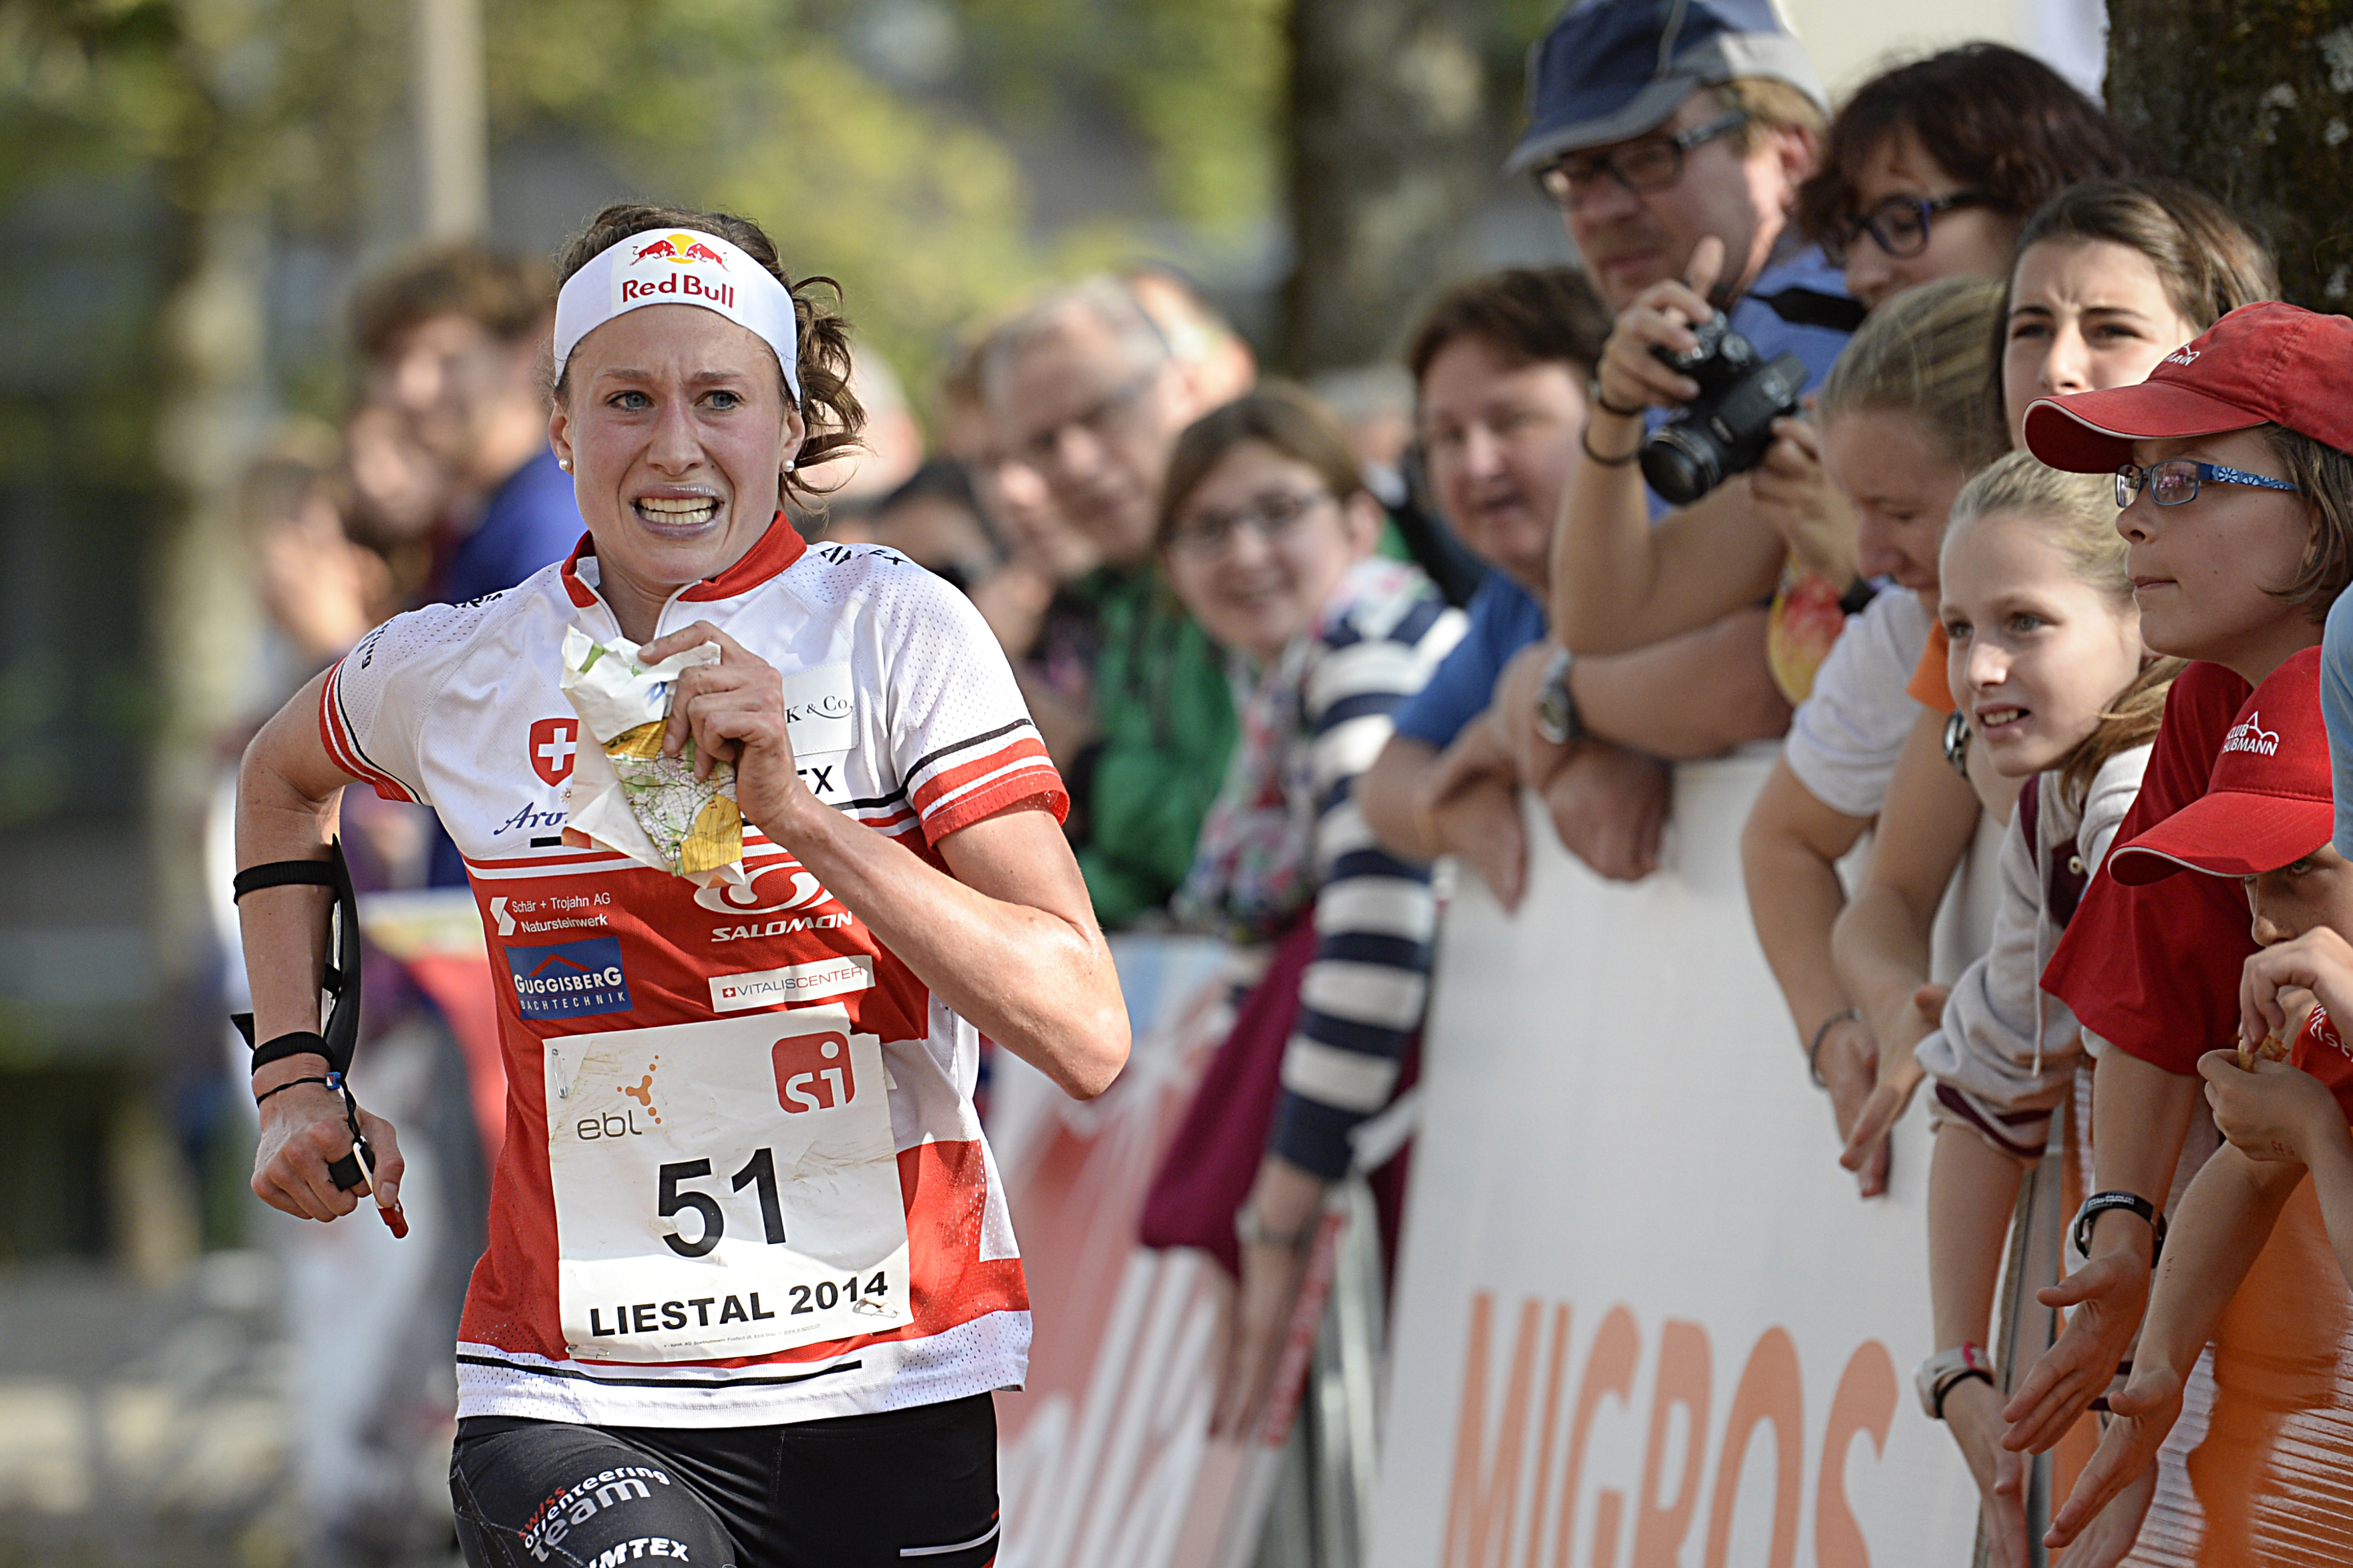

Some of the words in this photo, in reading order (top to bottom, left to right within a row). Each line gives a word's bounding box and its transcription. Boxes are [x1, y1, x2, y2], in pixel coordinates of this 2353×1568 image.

[622, 272, 677, 303] Red
[684, 274, 734, 309] Bull
[494, 802, 568, 835] Aro
[512, 900, 536, 913] Schär
[550, 896, 589, 912] Trojahn
[594, 892, 610, 906] AG
[521, 914, 608, 933] Natursteinwerk
[711, 911, 852, 942] SALOMON
[514, 966, 621, 994] GUGGISBERG
[737, 966, 862, 996] VITALISCENTER
[520, 992, 625, 1010] DACHTECHNIK
[576, 1110, 642, 1141] ebl
[658, 1147, 786, 1258] 51
[590, 1292, 775, 1337] LIESTAL
[789, 1271, 889, 1314] 2014
[1440, 1290, 1900, 1568] MIGROS
[524, 1466, 671, 1549] orienteering
[530, 1479, 651, 1563] team
